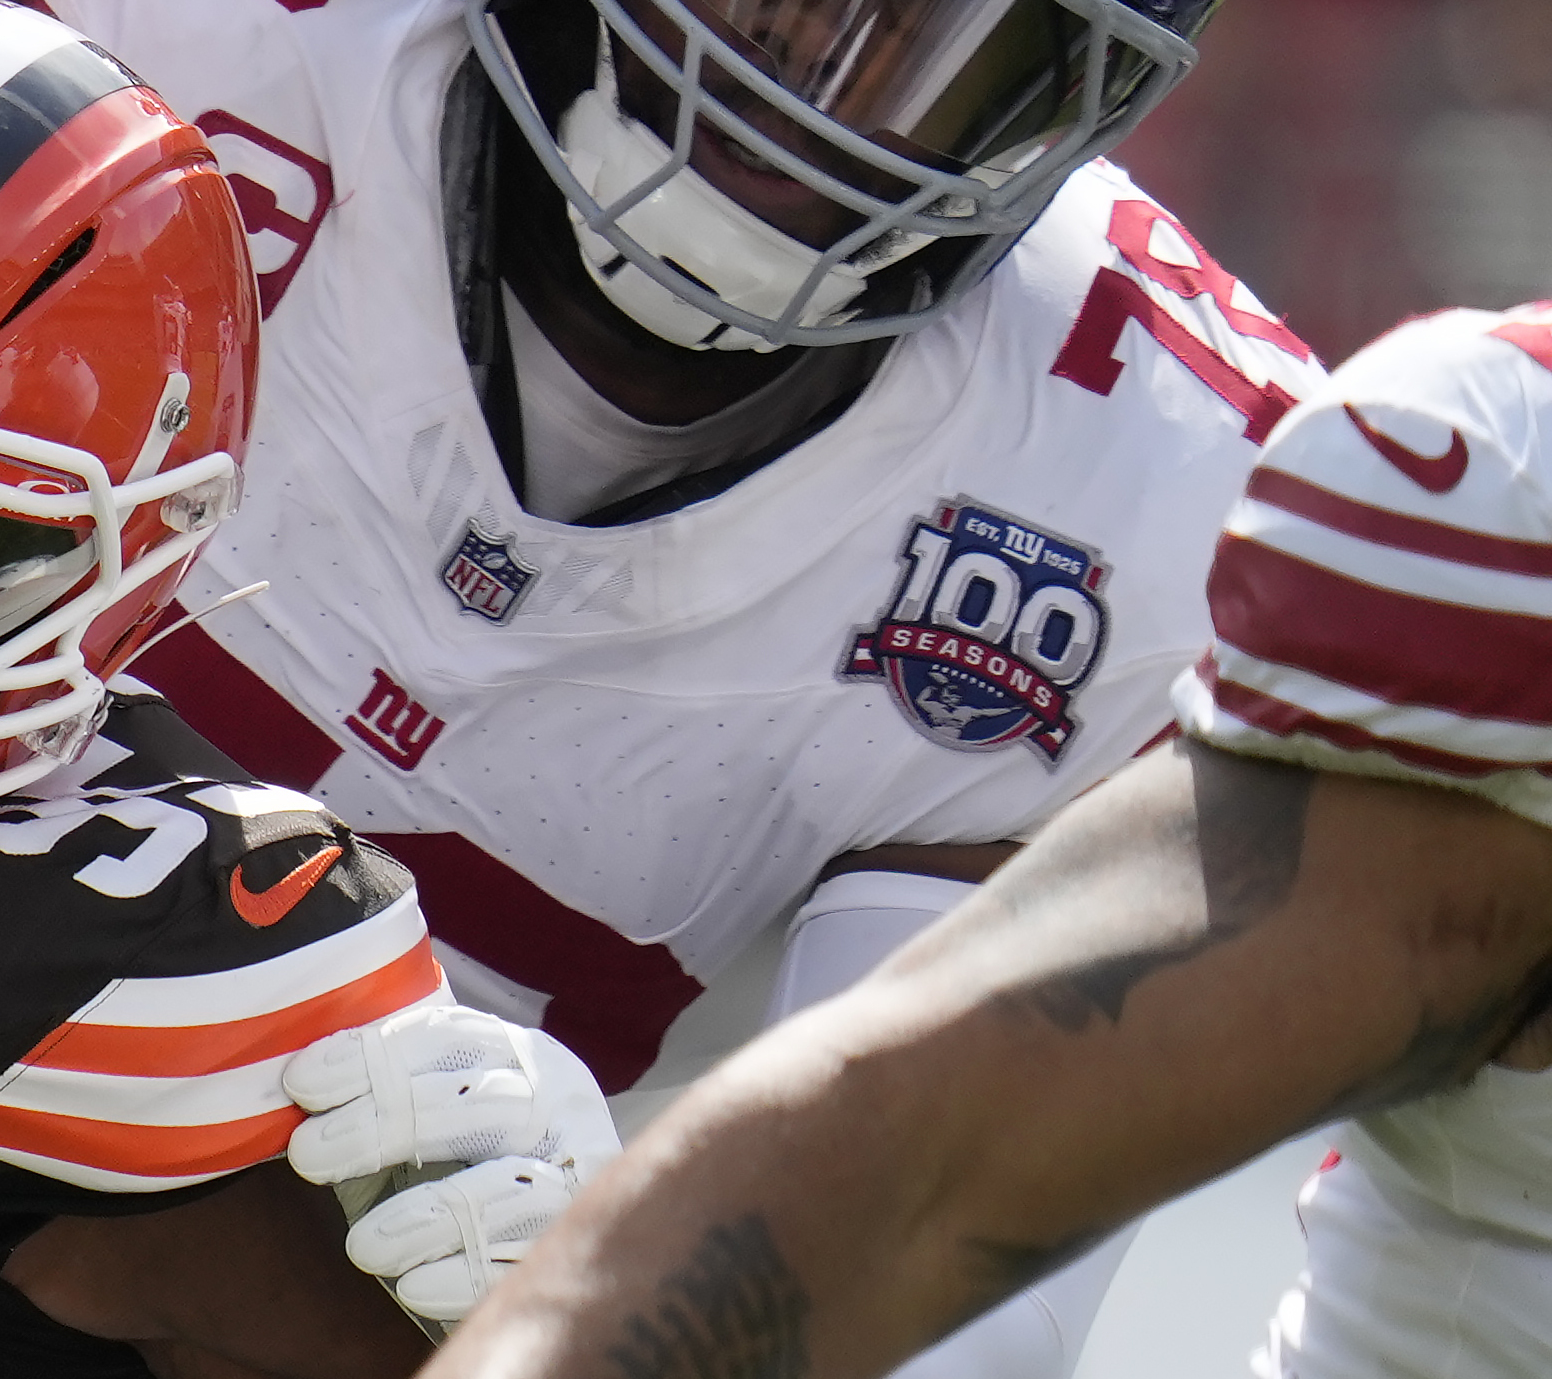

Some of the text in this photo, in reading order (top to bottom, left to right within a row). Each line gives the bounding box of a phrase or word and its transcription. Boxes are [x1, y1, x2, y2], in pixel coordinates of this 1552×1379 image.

[1049, 199, 1313, 447] 78
[446, 557, 505, 613] NFL
[964, 517, 1001, 542] EST.
[1042, 549, 1084, 576] 1925
[892, 524, 1100, 686] 100
[891, 629, 1053, 708] SEASONS
